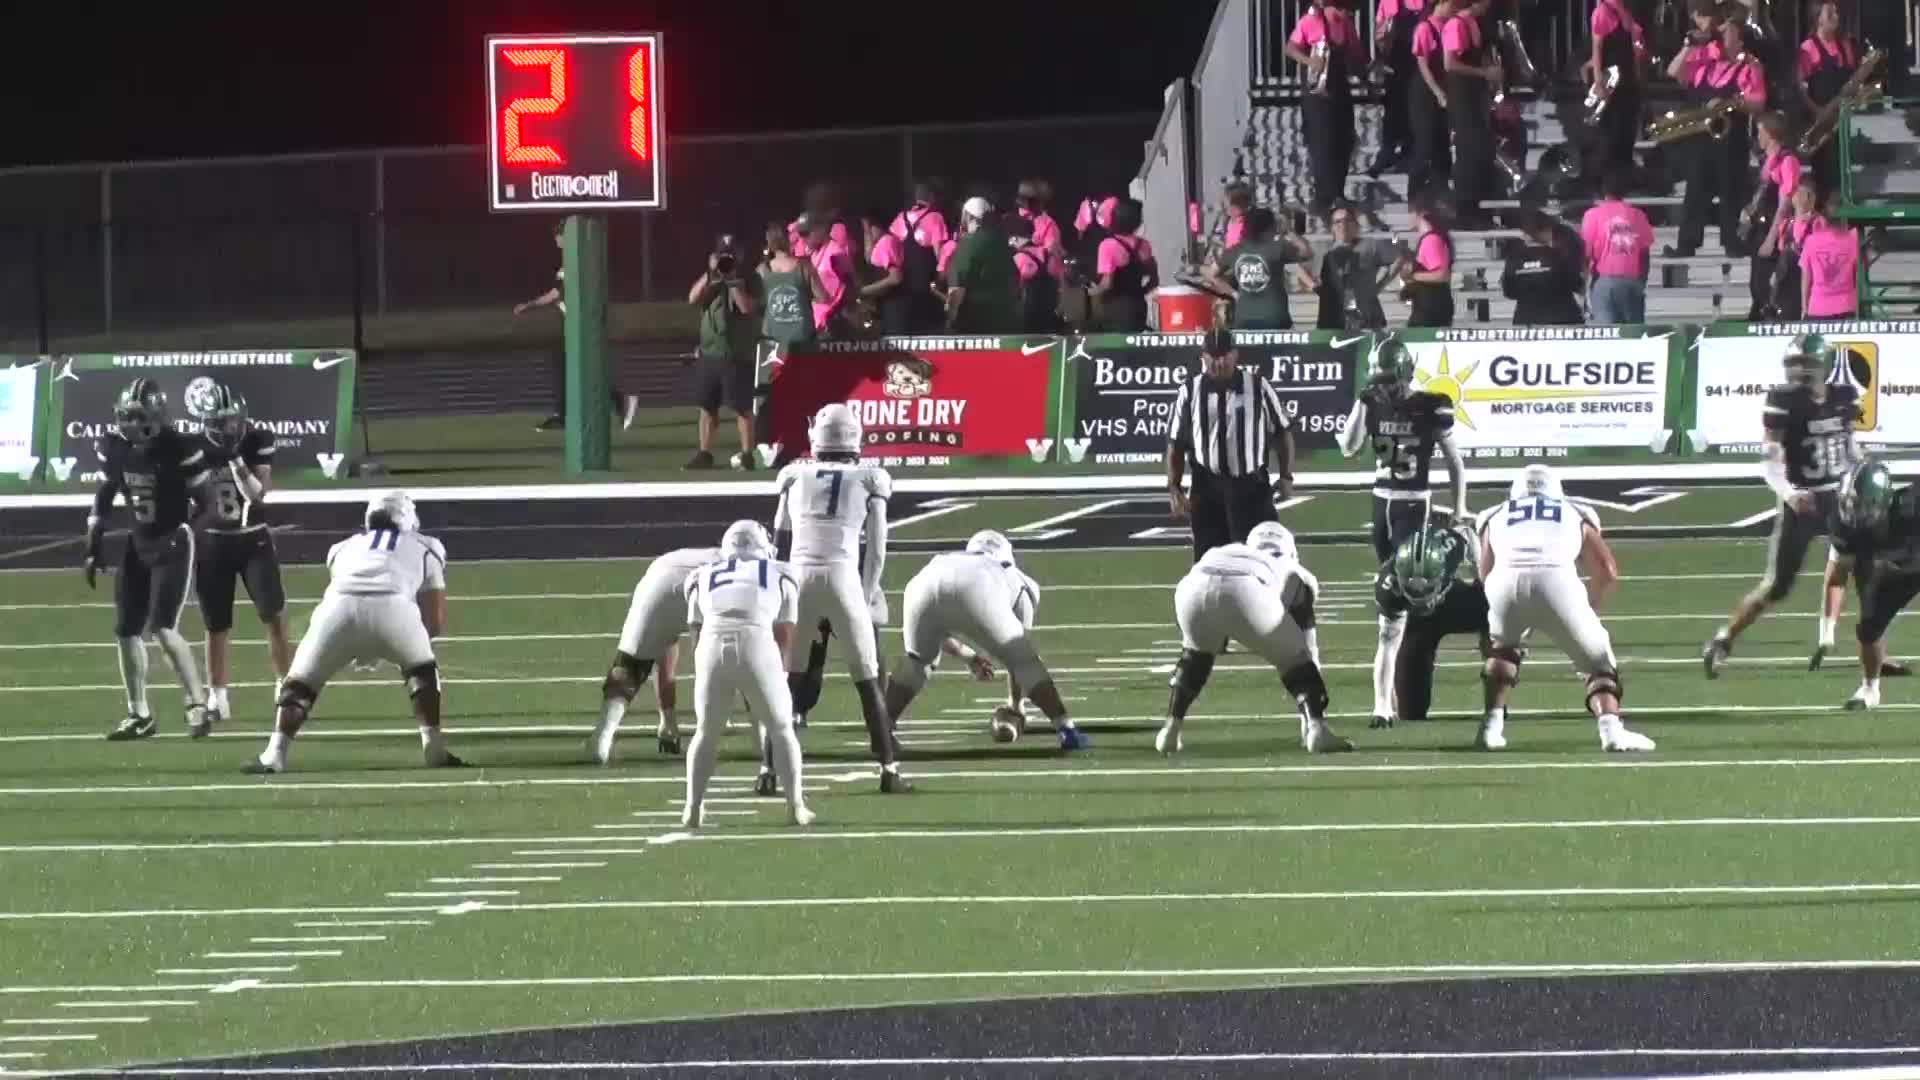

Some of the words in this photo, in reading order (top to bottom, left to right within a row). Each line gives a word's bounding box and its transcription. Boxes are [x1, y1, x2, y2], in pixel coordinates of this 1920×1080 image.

[502, 48, 647, 164] 21
[1095, 358, 1188, 386] Boone
[1271, 355, 1343, 382] Firm
[1489, 355, 1655, 387] GULFSIDE
[918, 398, 967, 425] DRY
[1490, 402, 1577, 415] MORTGAGE
[1581, 400, 1654, 413] SERVICES
[1081, 418, 1127, 436] VHS
[815, 469, 844, 516] 7
[1507, 497, 1562, 527] 56
